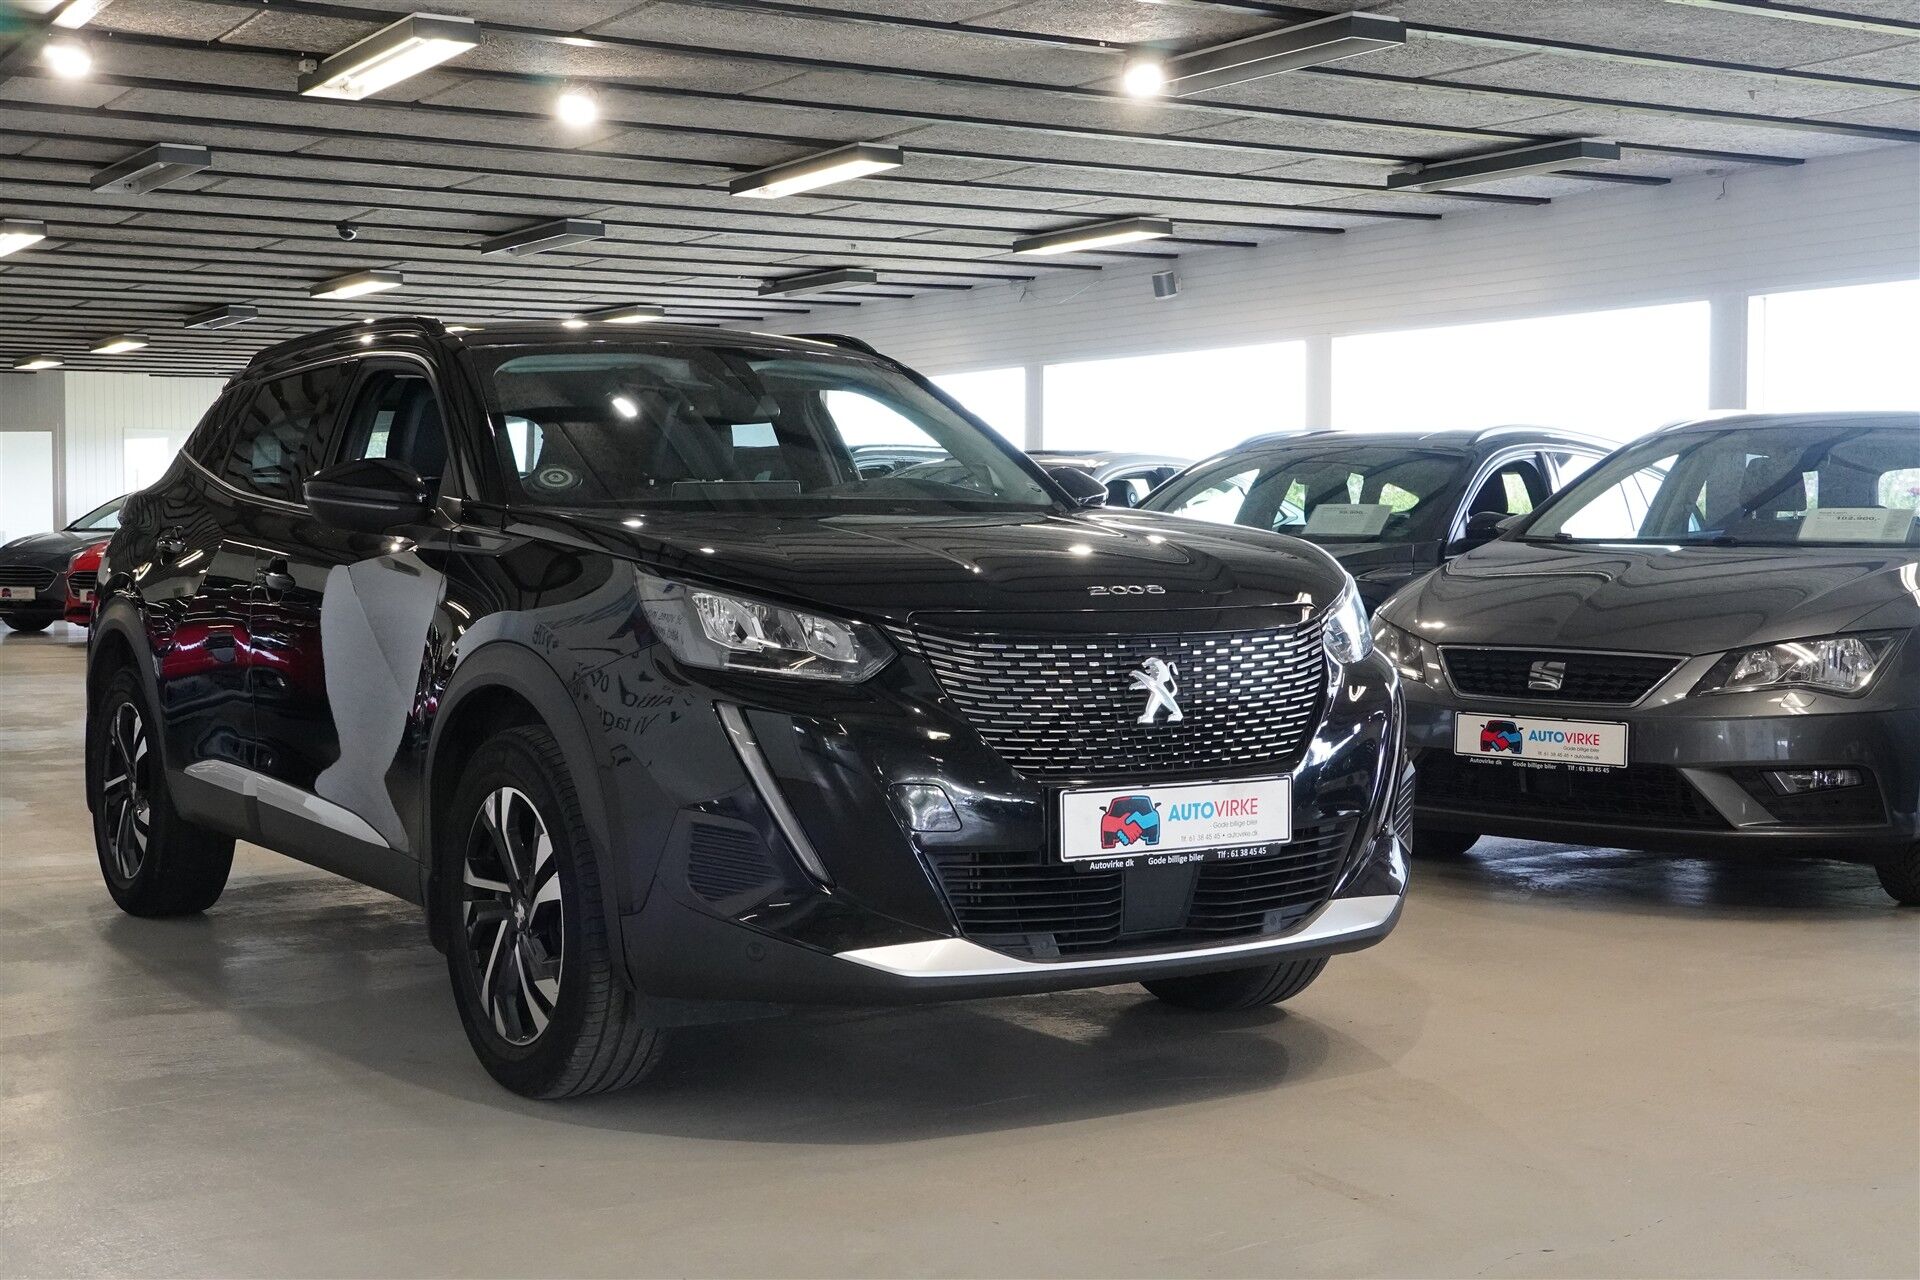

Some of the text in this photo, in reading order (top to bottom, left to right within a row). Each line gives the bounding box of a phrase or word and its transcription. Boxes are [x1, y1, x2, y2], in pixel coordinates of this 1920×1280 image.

[1086, 584, 1166, 596] 2008
[1528, 729, 1600, 747] AUTOVIRKE
[1512, 760, 1527, 768] Gode
[1527, 762, 1543, 770] billige
[1168, 797, 1259, 822] AUTOVIRKE
[1230, 849, 1239, 858] 61
[1239, 848, 1248, 857] 38
[1249, 847, 1258, 856] 45
[1258, 846, 1267, 856] 45
[1089, 859, 1135, 870] Autovirke dk
[1148, 853, 1204, 865] Gode billige biler
